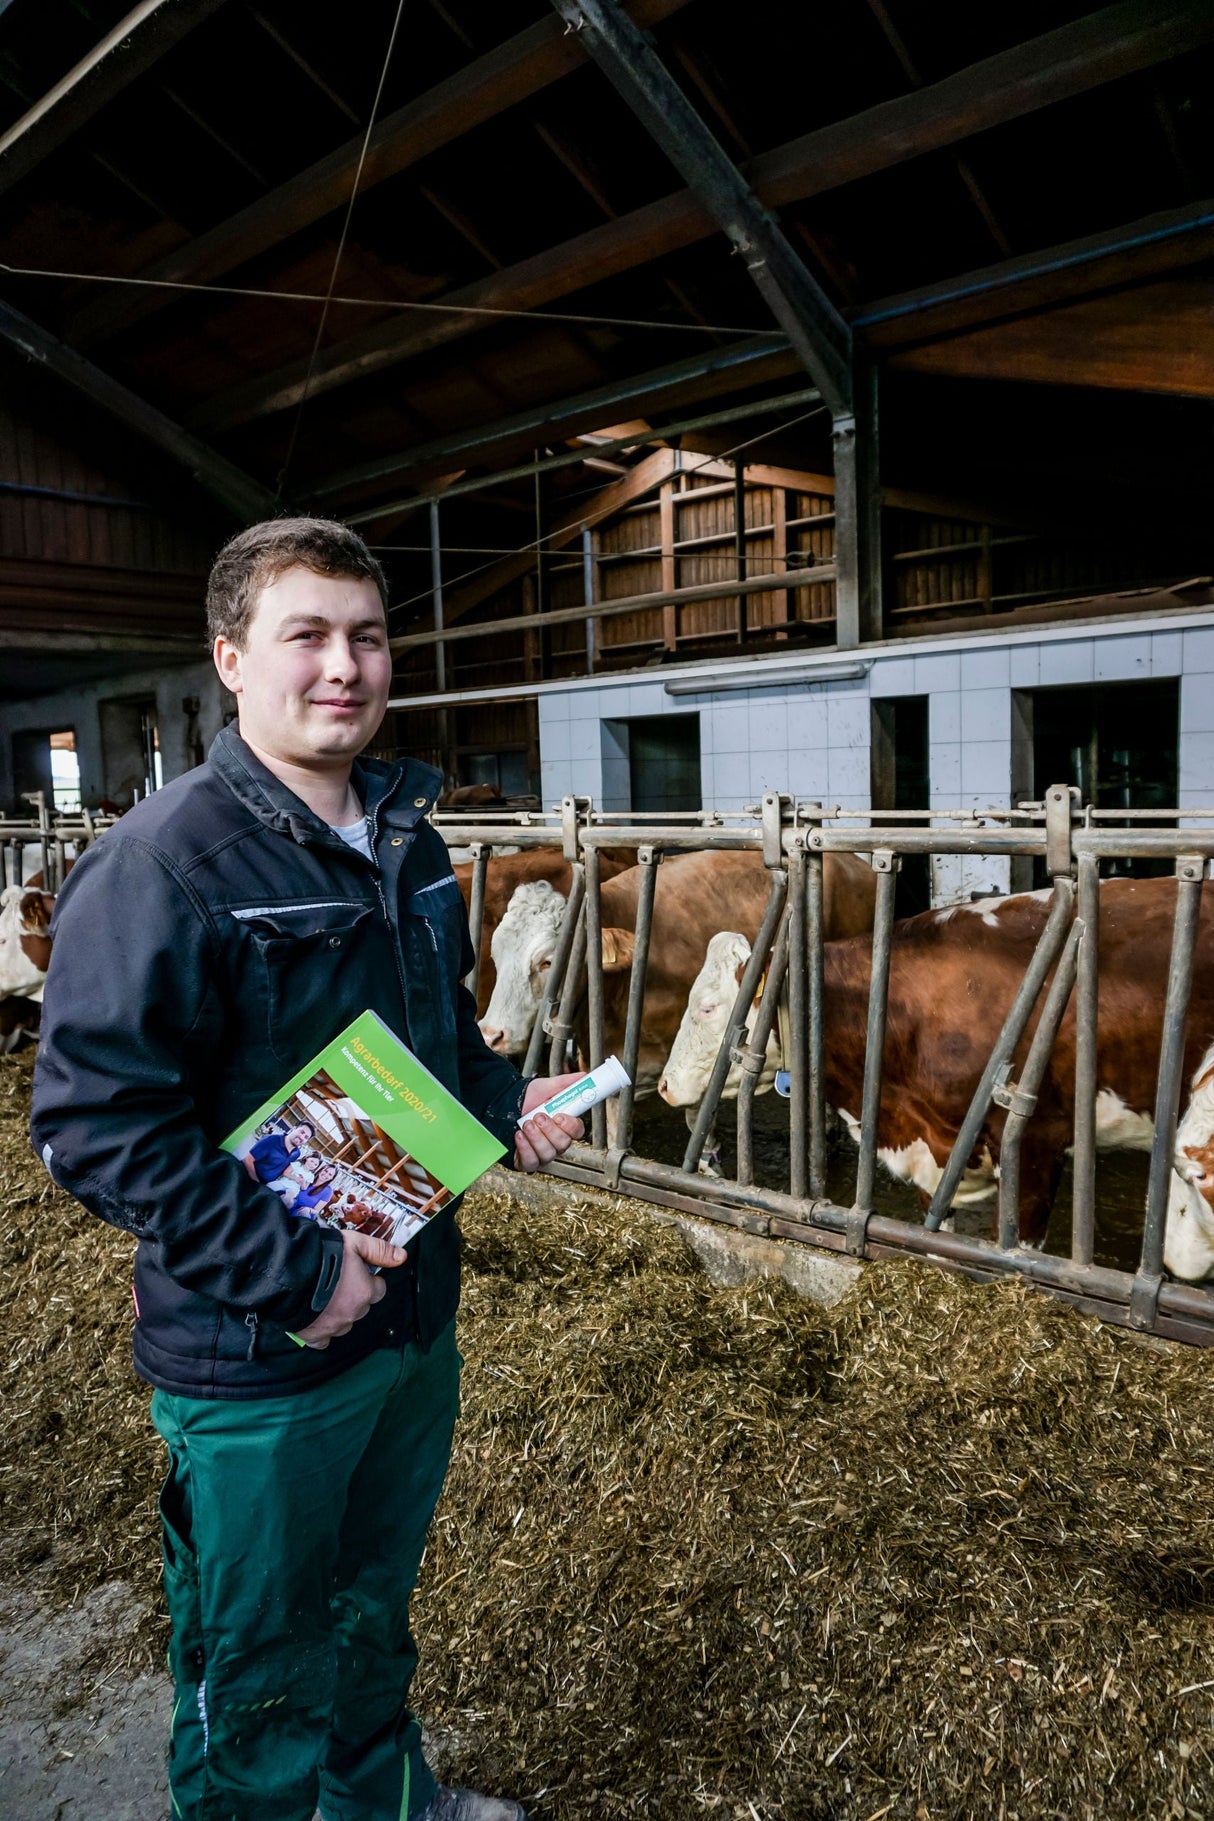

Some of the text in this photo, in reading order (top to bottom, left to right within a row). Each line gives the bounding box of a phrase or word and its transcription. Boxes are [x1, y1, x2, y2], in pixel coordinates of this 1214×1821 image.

[341, 1046, 369, 1078] Kompetenz
[366, 1074, 377, 1085] für
[382, 1090, 395, 1102] Tier
[351, 1036, 437, 1123] Agrarbedarf 2020/21
